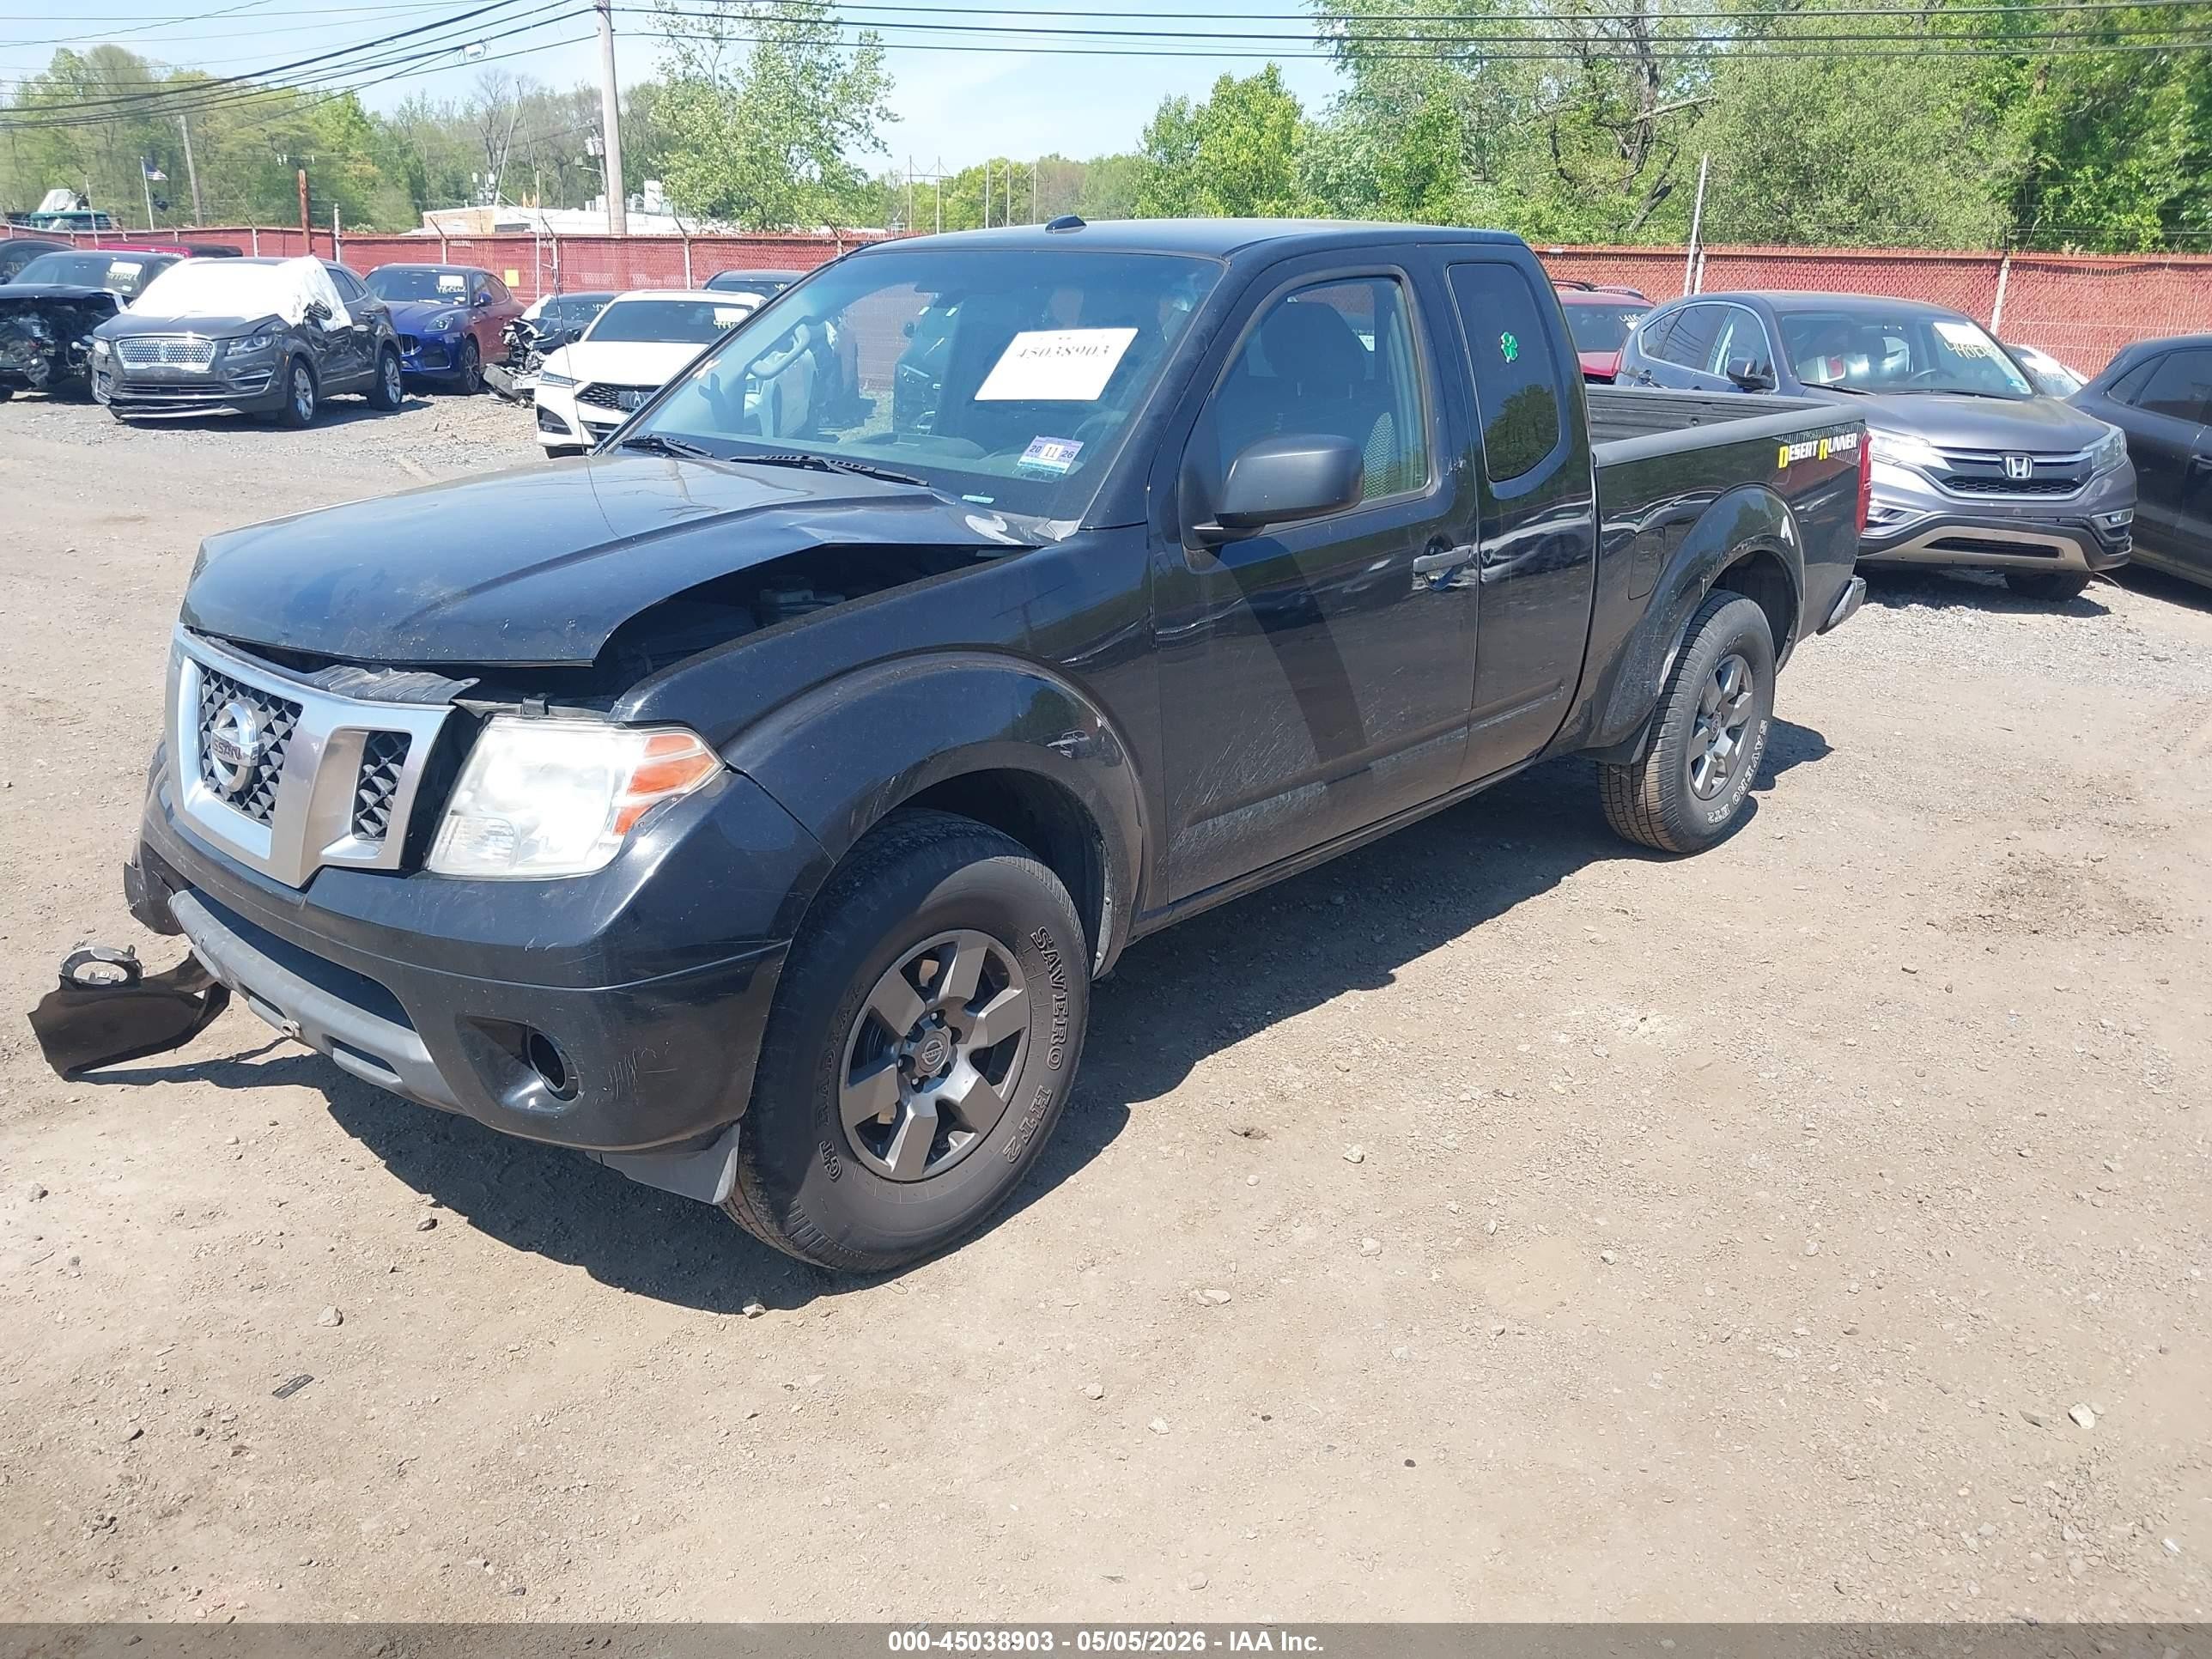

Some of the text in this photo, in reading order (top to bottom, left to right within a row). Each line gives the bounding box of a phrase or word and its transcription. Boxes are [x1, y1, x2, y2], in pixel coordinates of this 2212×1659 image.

[1030, 445, 1075, 459] 20 11 26
[1778, 433, 1856, 469] DESERT RUNNER
[1732, 720, 1767, 805] SAVERO
[1030, 926, 1067, 1070] SAVERO
[819, 1139, 842, 1182] GT
